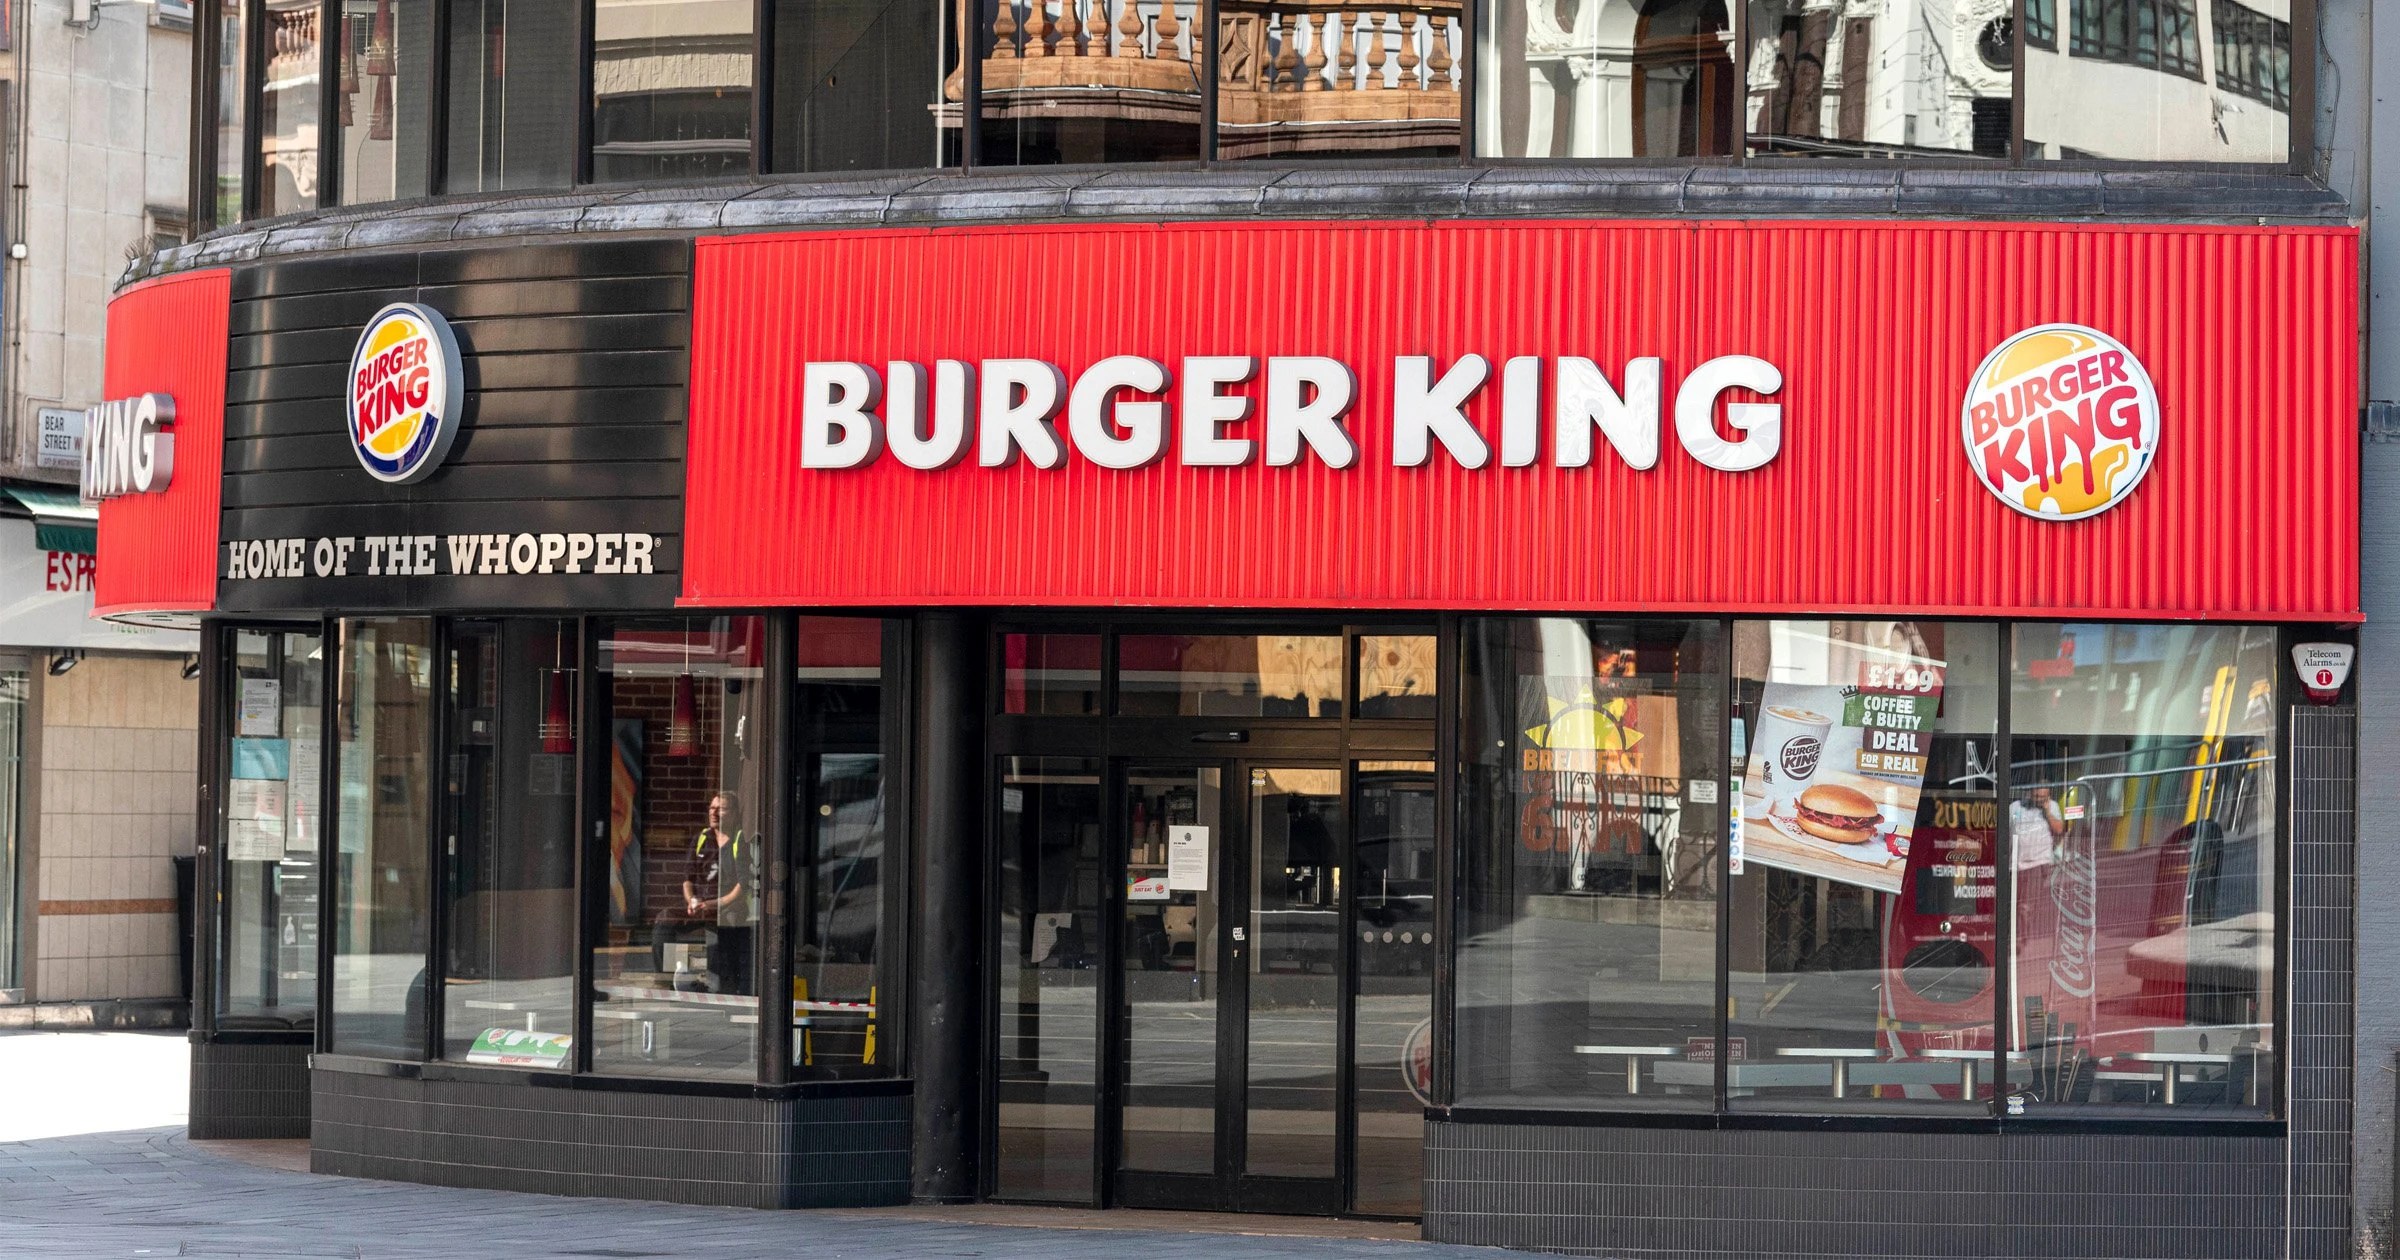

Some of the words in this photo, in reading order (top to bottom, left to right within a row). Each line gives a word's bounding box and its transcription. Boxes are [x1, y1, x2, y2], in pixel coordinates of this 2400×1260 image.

[357, 337, 428, 402] BURGER
[358, 366, 430, 446] KING
[1970, 350, 2129, 447] BURGER
[45, 416, 64, 432] BEAR
[801, 354, 1360, 471] BURGER
[1393, 353, 1783, 472] KING
[44, 434, 72, 451] STREET
[1983, 385, 2142, 496] KING
[228, 538, 306, 580] HOME
[314, 537, 356, 578] OF
[364, 535, 437, 576] THE
[447, 533, 654, 575] WHOPPER
[2307, 649, 2342, 658] Telecom
[1868, 665, 1934, 693] £1.99
[1863, 696, 1915, 715] COFFEE
[1862, 710, 1873, 726] &
[1876, 711, 1922, 730] BUTTY
[1785, 743, 1821, 757] BURGER
[1872, 730, 1919, 753] DEAL
[1523, 749, 1645, 776] BREFAST
[1784, 751, 1821, 769] KING
[1861, 754, 1879, 764] FOR
[1883, 755, 1919, 773] REAL
